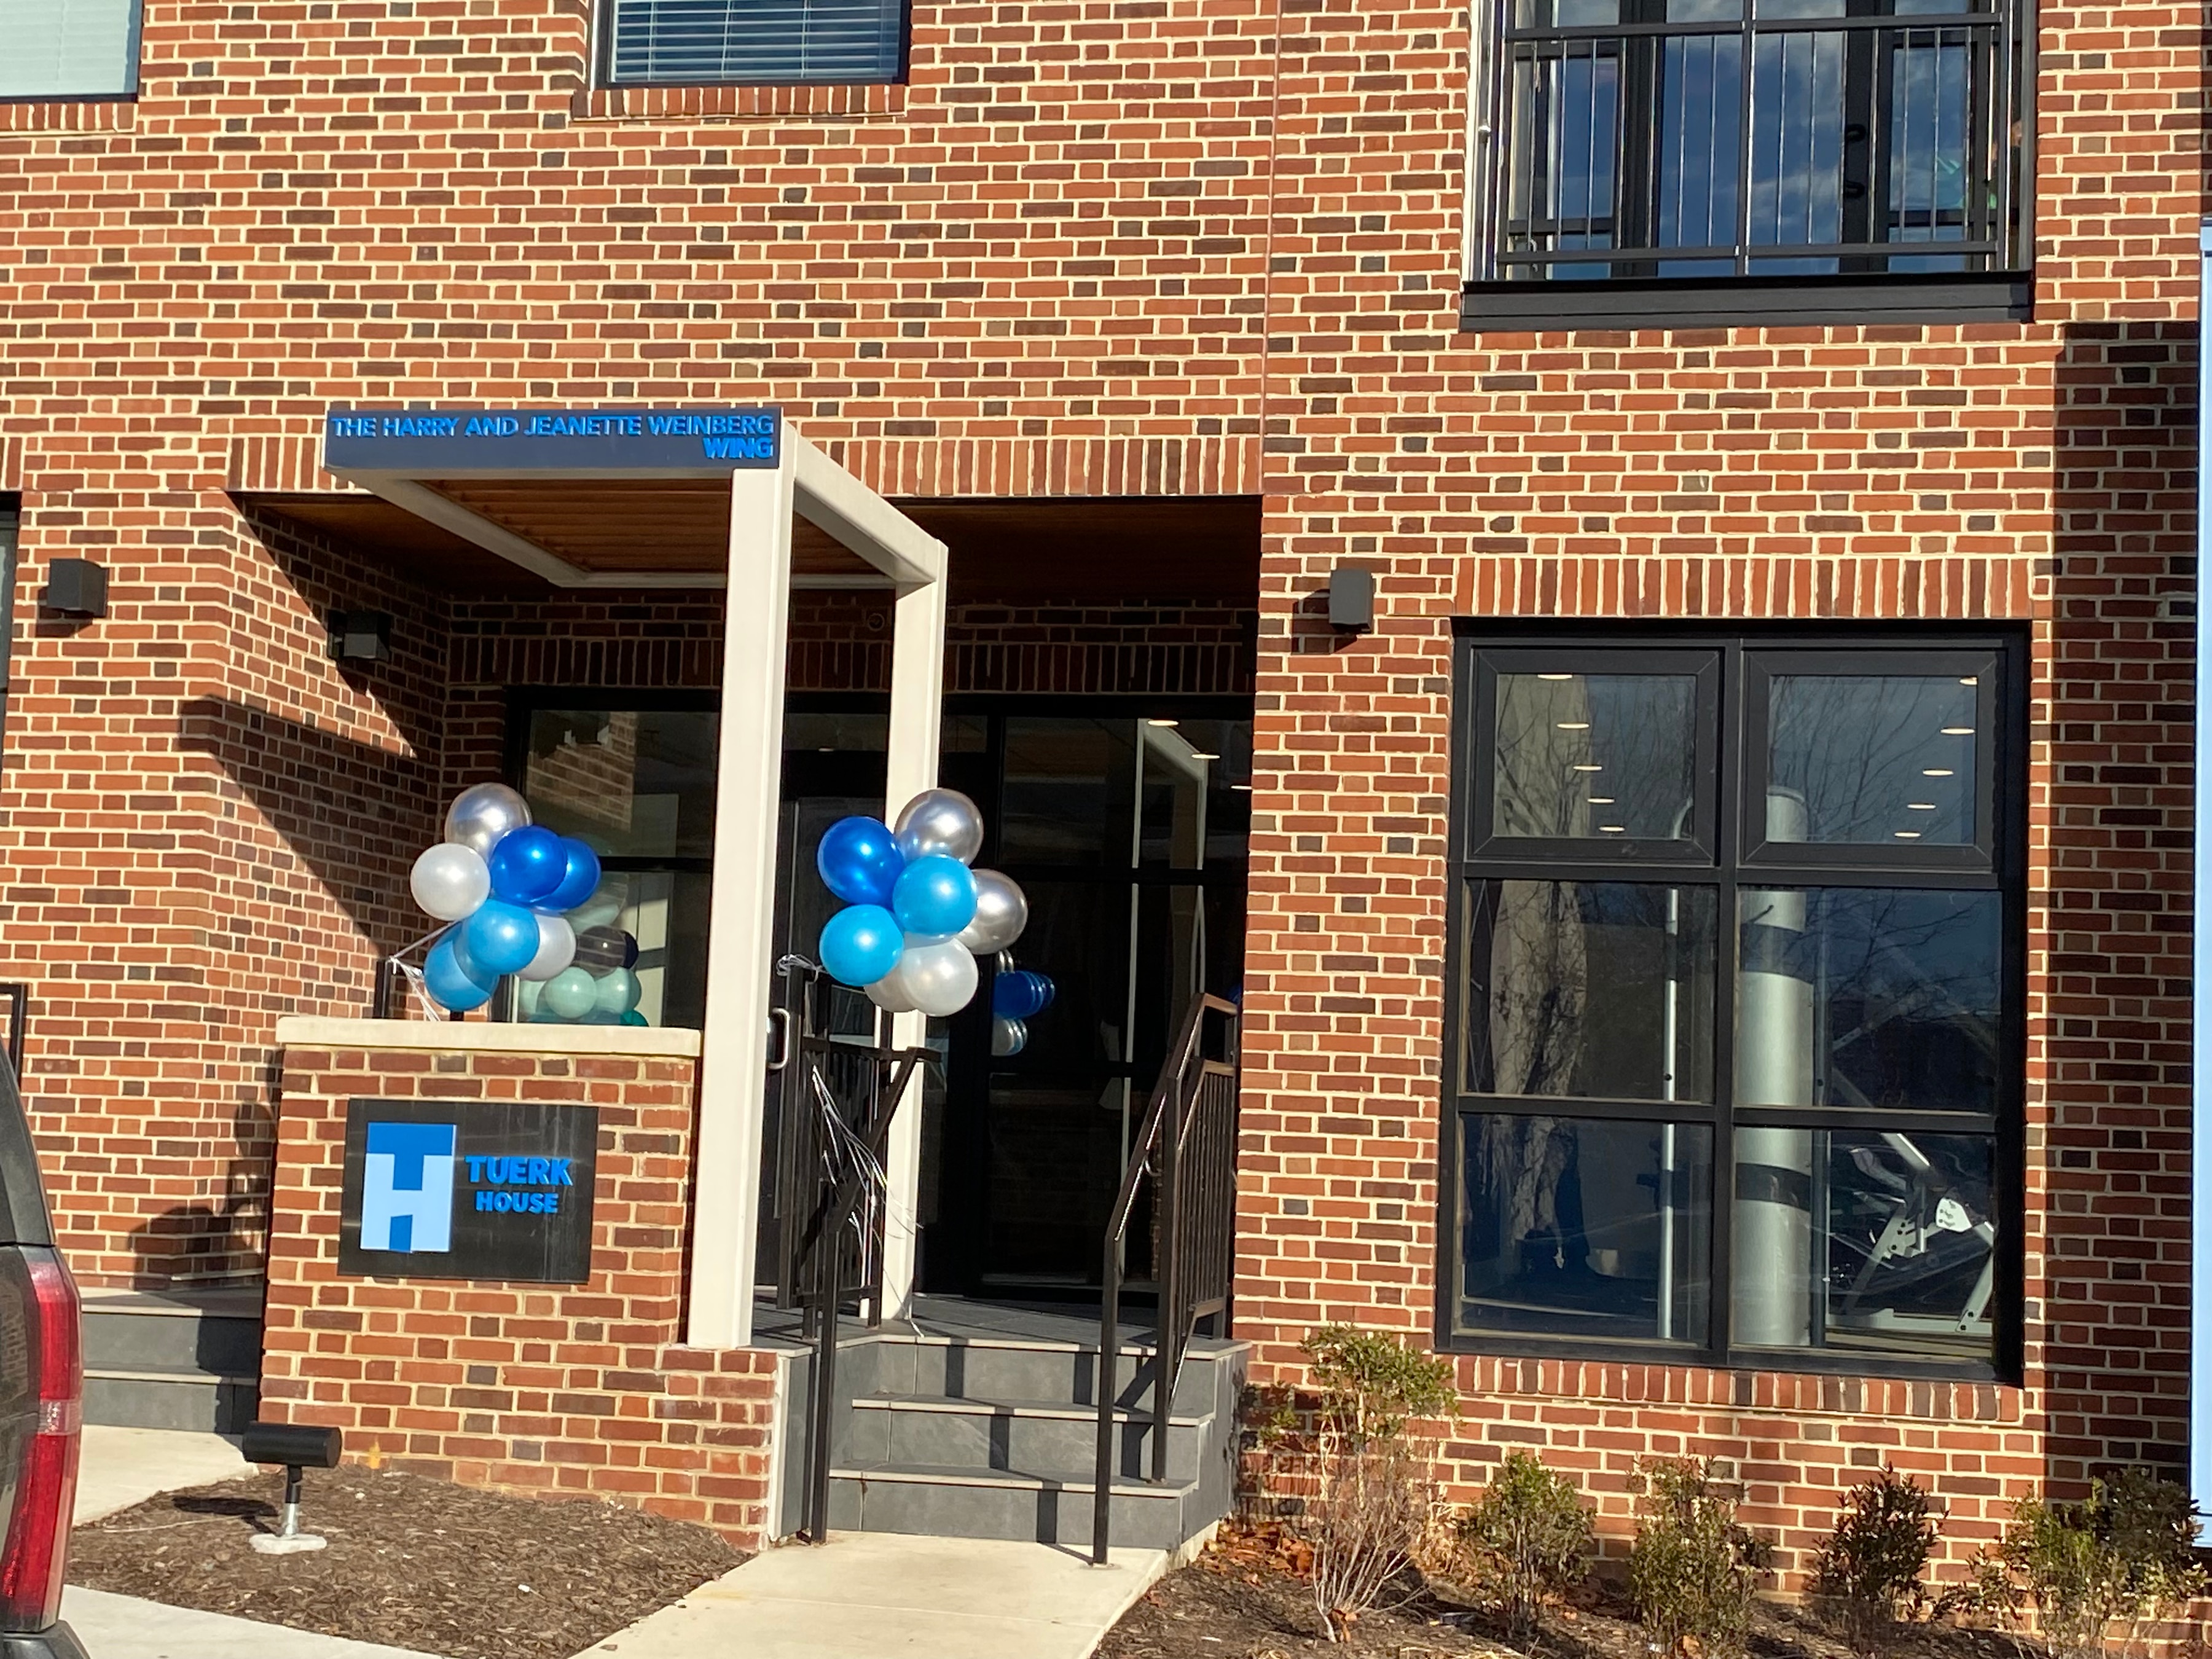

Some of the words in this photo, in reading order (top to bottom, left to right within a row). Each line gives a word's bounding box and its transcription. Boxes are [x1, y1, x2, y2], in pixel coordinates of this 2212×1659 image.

[331, 417, 377, 437] THE
[383, 417, 460, 437] HARRY
[464, 416, 519, 437] AND
[524, 415, 641, 437] JEANETTE
[647, 415, 775, 436] WEINBERG
[703, 437, 774, 460] WING
[465, 1155, 573, 1186] TUERK
[474, 1190, 559, 1214] HOUSE
